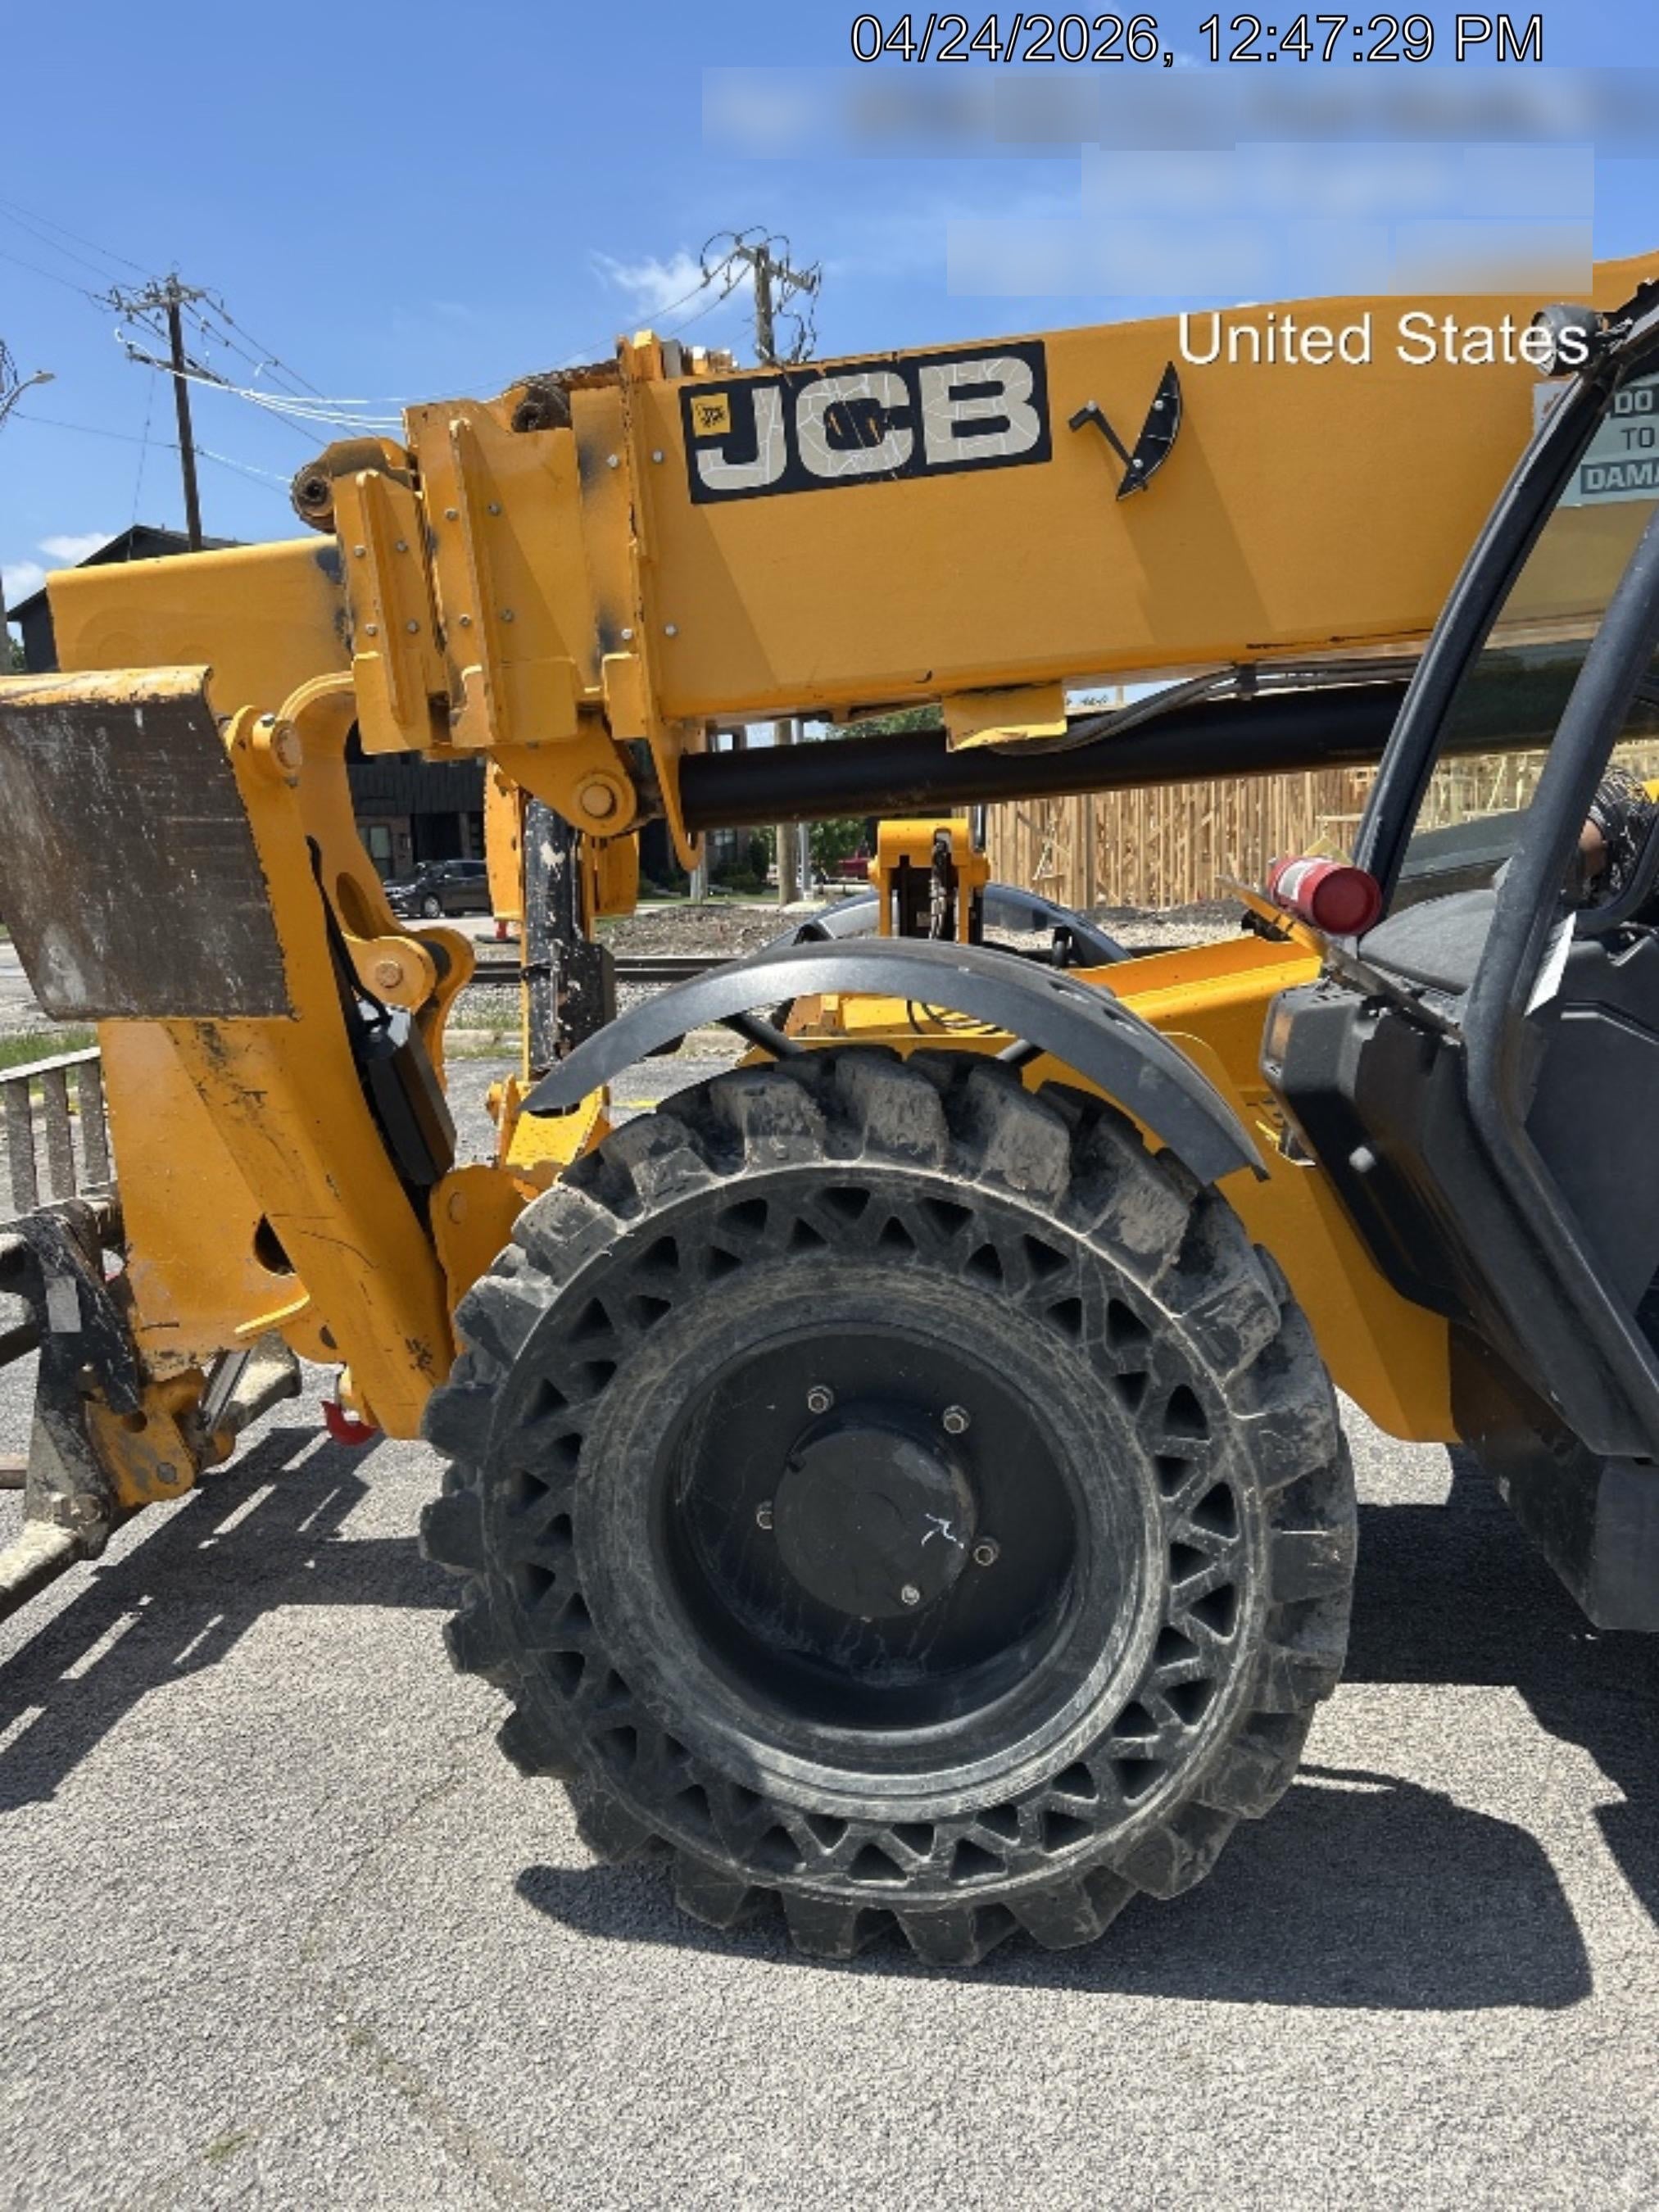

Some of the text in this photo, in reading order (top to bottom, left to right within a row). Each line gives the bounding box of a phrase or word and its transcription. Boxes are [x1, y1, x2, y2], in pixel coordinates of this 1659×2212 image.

[1614, 389, 1653, 414] DO
[696, 356, 1040, 490] JCB
[1620, 427, 1655, 450] TO
[1587, 464, 1659, 490] DAM
